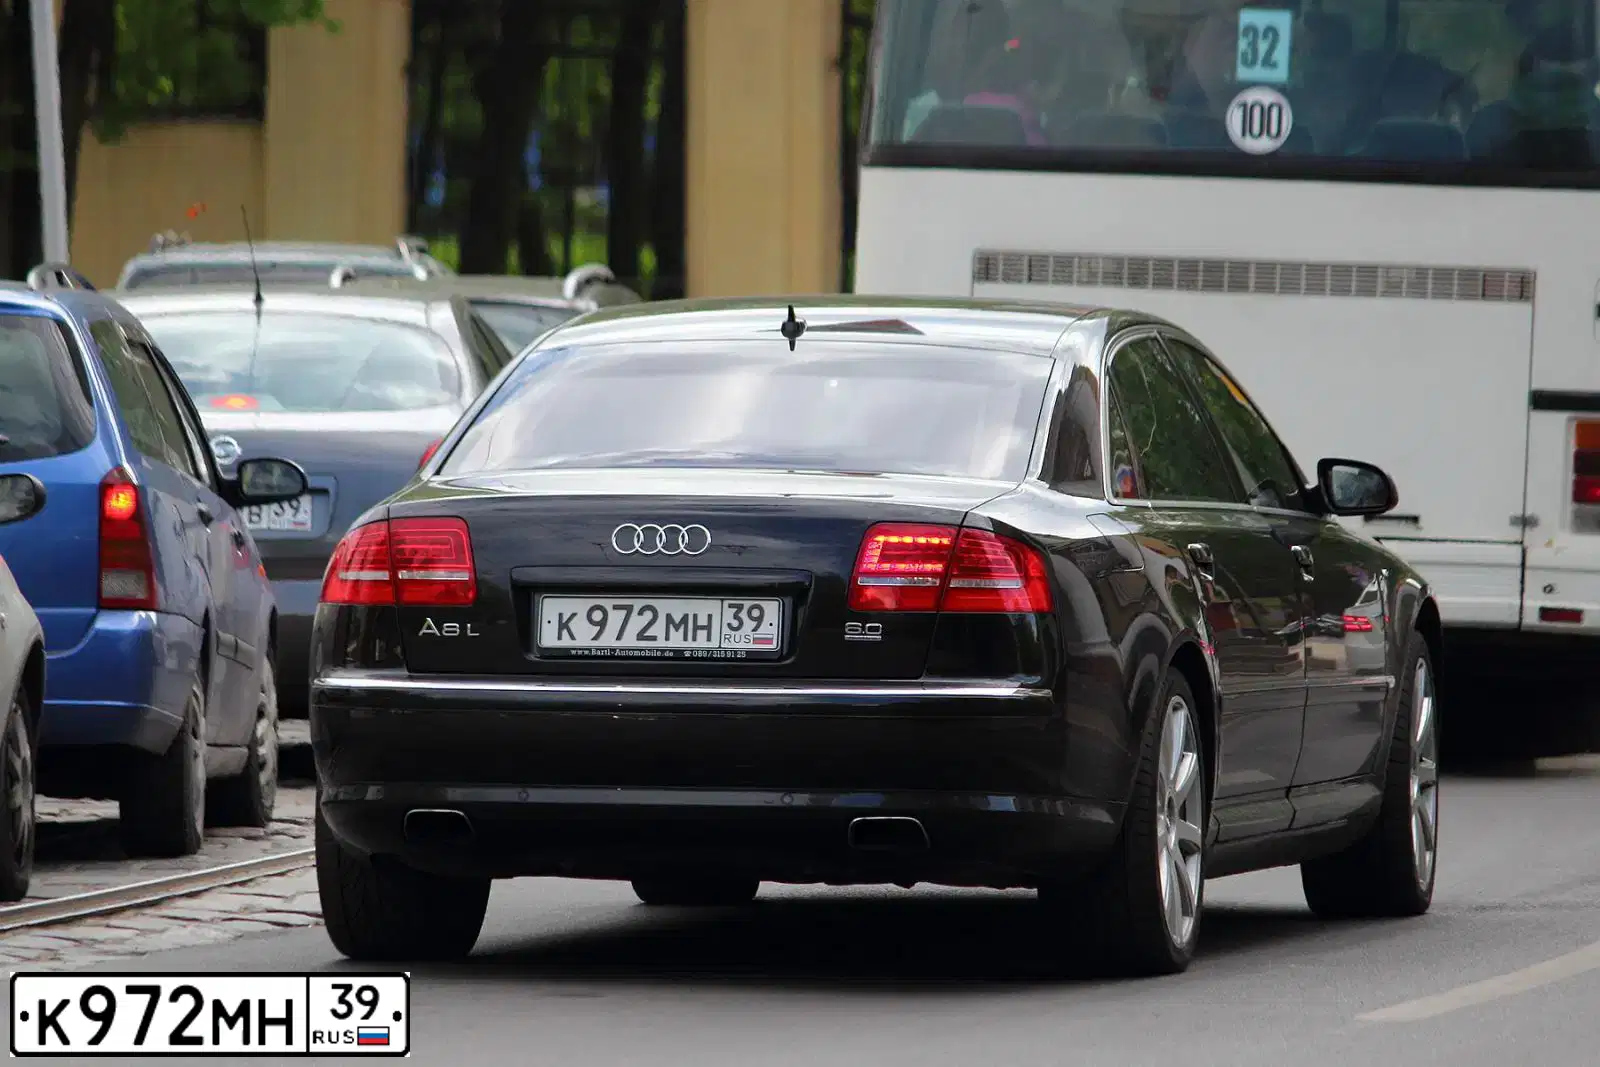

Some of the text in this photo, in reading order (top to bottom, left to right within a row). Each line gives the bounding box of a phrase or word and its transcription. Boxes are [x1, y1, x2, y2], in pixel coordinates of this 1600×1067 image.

[1240, 23, 1280, 69] 32
[1236, 101, 1283, 139] 100
[418, 617, 480, 637] A8 L
[557, 603, 765, 643] K972MH 39
[844, 621, 882, 635] 6.0
[723, 633, 751, 644] RUS
